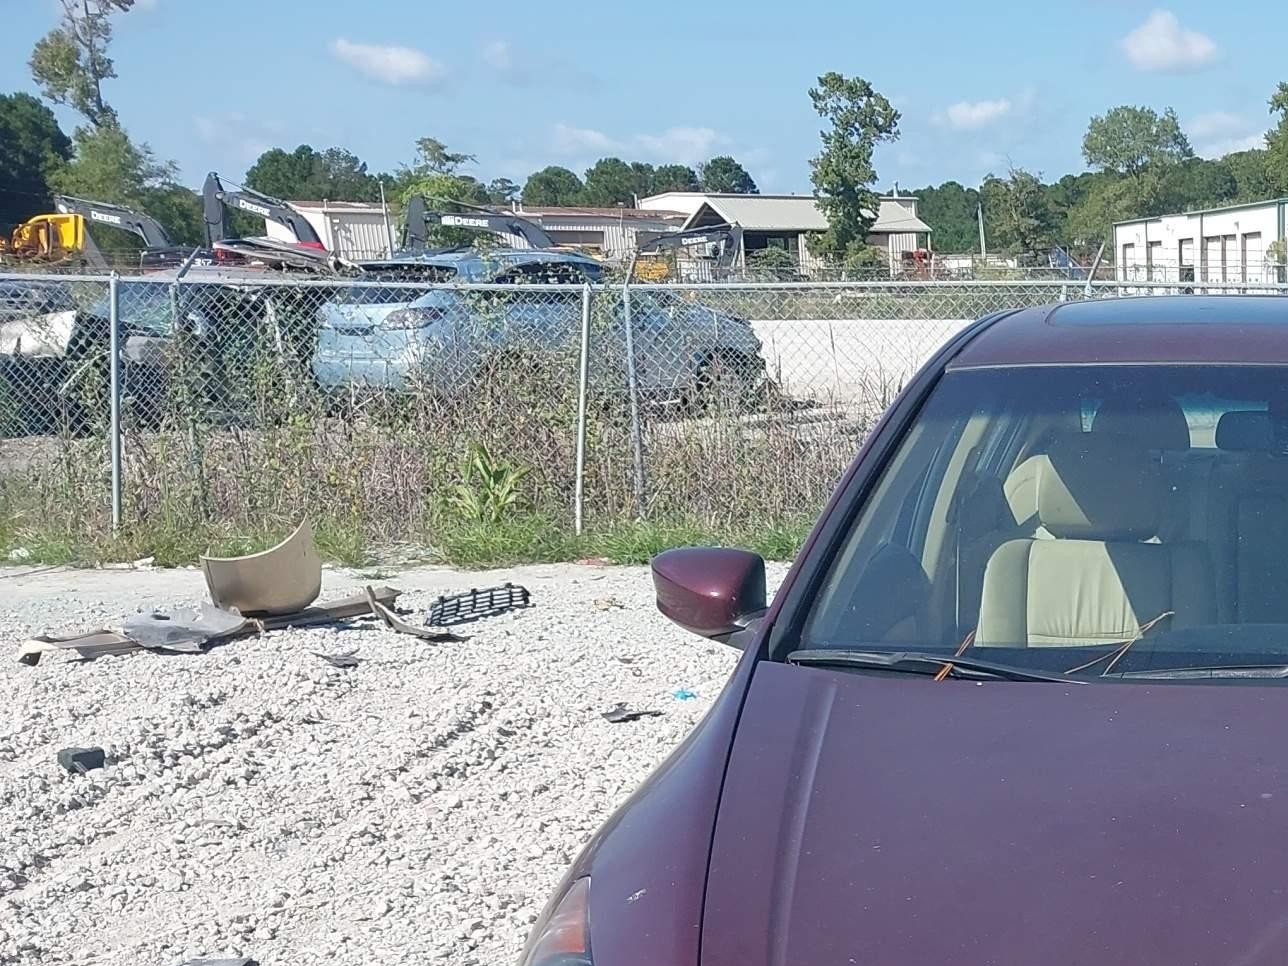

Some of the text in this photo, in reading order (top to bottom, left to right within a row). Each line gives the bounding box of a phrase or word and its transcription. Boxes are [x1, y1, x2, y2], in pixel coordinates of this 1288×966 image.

[239, 199, 270, 216] DEERE
[91, 210, 120, 224] DEERE
[454, 216, 489, 227] DEERE
